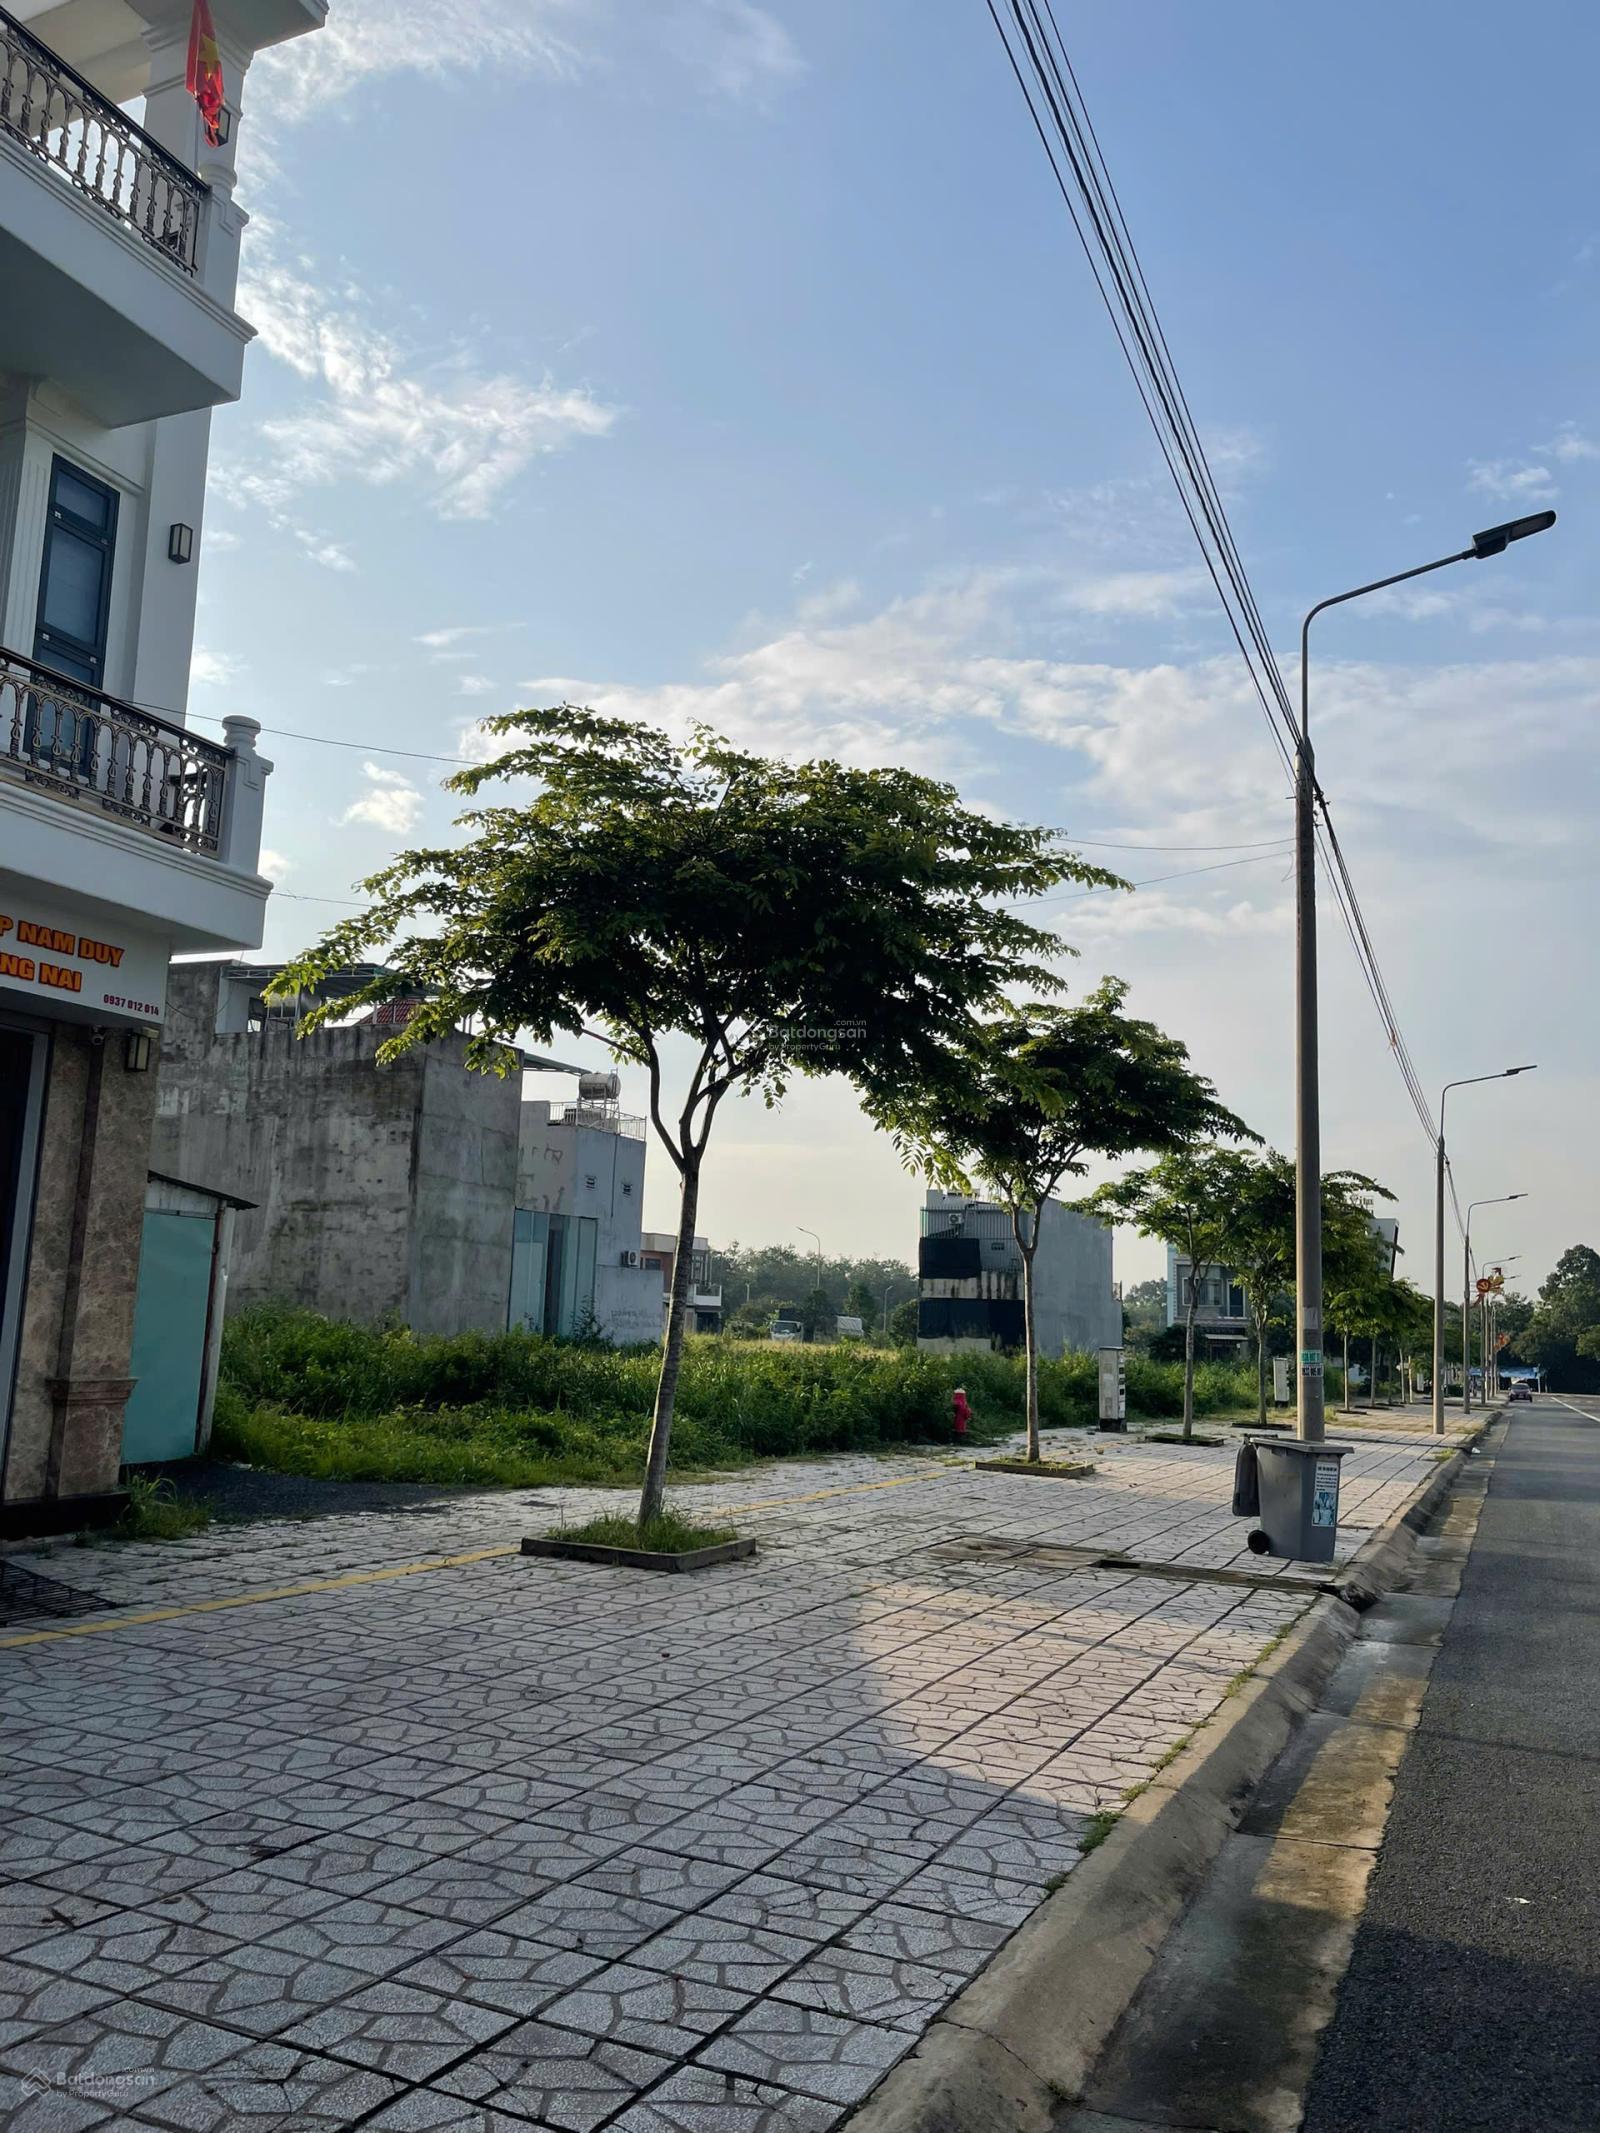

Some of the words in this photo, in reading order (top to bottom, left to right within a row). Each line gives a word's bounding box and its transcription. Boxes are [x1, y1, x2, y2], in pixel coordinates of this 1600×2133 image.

[17, 920, 76, 955] NAM
[78, 937, 125, 967] DUY
[39, 962, 82, 992] NAI
[103, 994, 126, 1008] 0937
[127, 1000, 143, 1012] 012
[144, 1004, 159, 1016] 014
